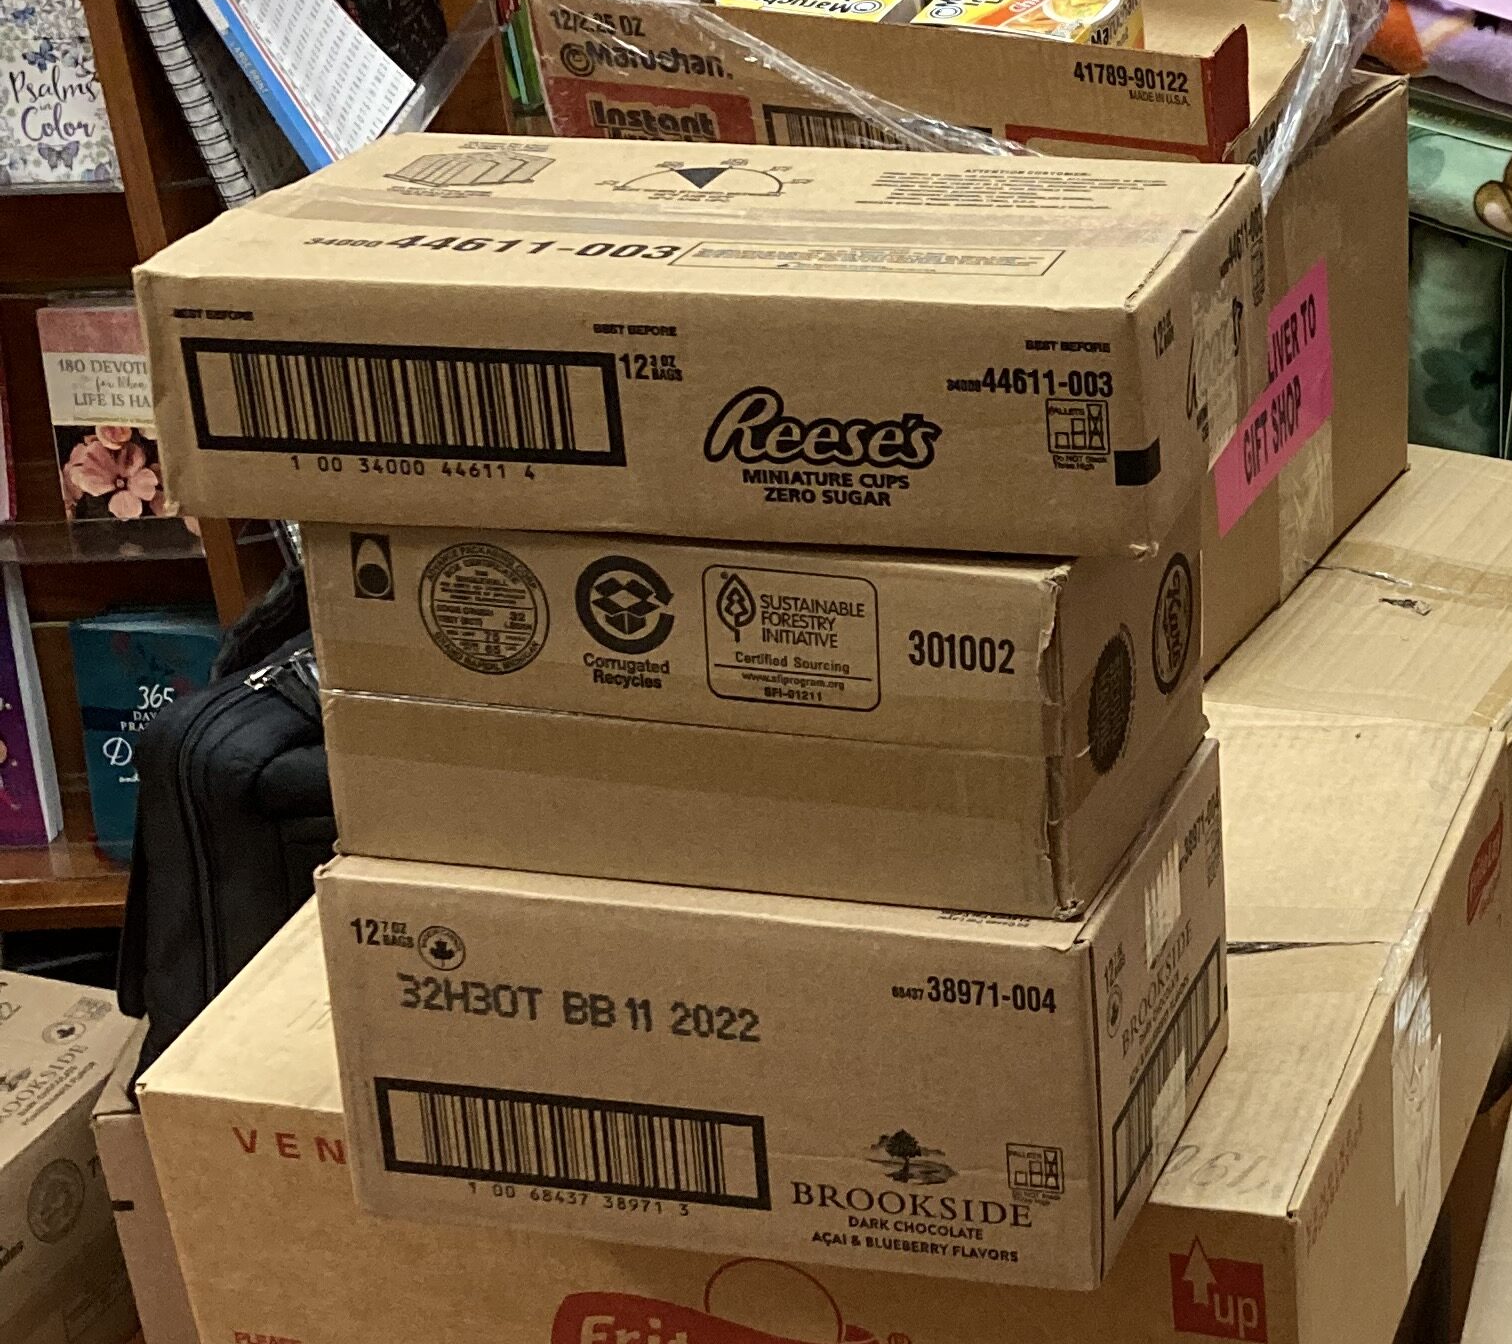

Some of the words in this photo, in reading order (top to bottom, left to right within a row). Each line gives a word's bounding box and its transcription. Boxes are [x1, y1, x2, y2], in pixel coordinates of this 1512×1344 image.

[8, 61, 97, 105] Psalms
[1073, 61, 1189, 93] 41789-90122
[20, 103, 97, 142] Color
[589, 99, 716, 139] Instant
[382, 233, 685, 262] 44611-003
[627, 325, 677, 337] BEFORE
[1060, 341, 1111, 353] BEFORE
[1268, 311, 1300, 384] LIVER
[58, 359, 85, 372] 180
[618, 353, 650, 379] 12
[982, 367, 1113, 397] 44611-003
[73, 393, 106, 406] LIFE
[703, 385, 942, 471] Reese's
[1243, 409, 1269, 486] GIFT
[1270, 374, 1302, 454] SHOP
[358, 458, 426, 476] 34000
[441, 462, 507, 479] 44611
[742, 467, 854, 489] MINIATURE
[857, 471, 911, 491] CUPS
[764, 487, 817, 505] ZERO
[822, 488, 891, 509] SUGAR
[760, 594, 865, 618] SUSTAINABLE
[761, 612, 835, 632] FORESTRY
[762, 628, 838, 648] INITIATIVE
[583, 652, 671, 675] Corrugated
[735, 651, 788, 668] Certified
[794, 656, 850, 674] Sourcing
[908, 630, 1015, 675] 301002
[593, 668, 662, 690] Recycles
[137, 684, 175, 710] 365
[351, 918, 381, 947] 12
[926, 976, 1057, 1013] 38971-004
[563, 990, 616, 1029] BB
[625, 997, 652, 1032] 11
[670, 1002, 761, 1043] 2022
[529, 1187, 588, 1206] 68437
[603, 1195, 664, 1215] 38971
[790, 1181, 1032, 1228] BROOKSIDE
[848, 1216, 889, 1230] DARK
[893, 1219, 983, 1241] CHOCOLATE
[812, 1231, 847, 1247] AÇAI
[865, 1236, 948, 1256] BLUEBERRY
[952, 1244, 1018, 1263] FLAVORS
[1213, 1288, 1260, 1333] up
